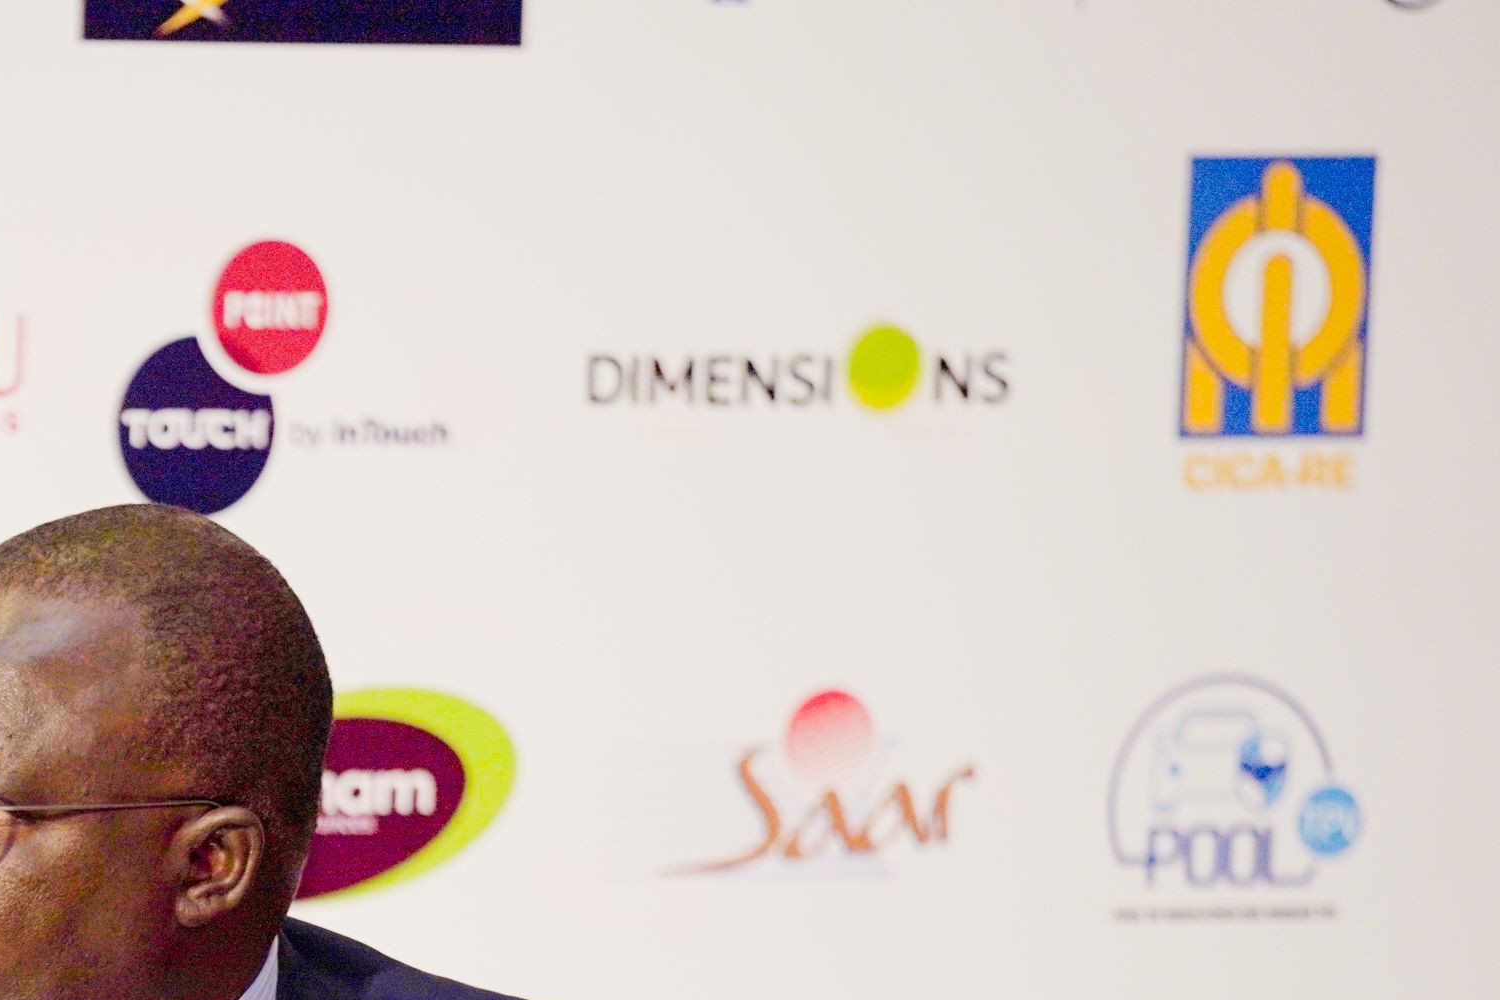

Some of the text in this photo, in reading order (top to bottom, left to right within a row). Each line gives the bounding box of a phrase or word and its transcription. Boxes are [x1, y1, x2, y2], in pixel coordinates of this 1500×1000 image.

[222, 290, 321, 329] POINT
[119, 407, 270, 450] TOUCH
[1144, 821, 1318, 889] POOL
